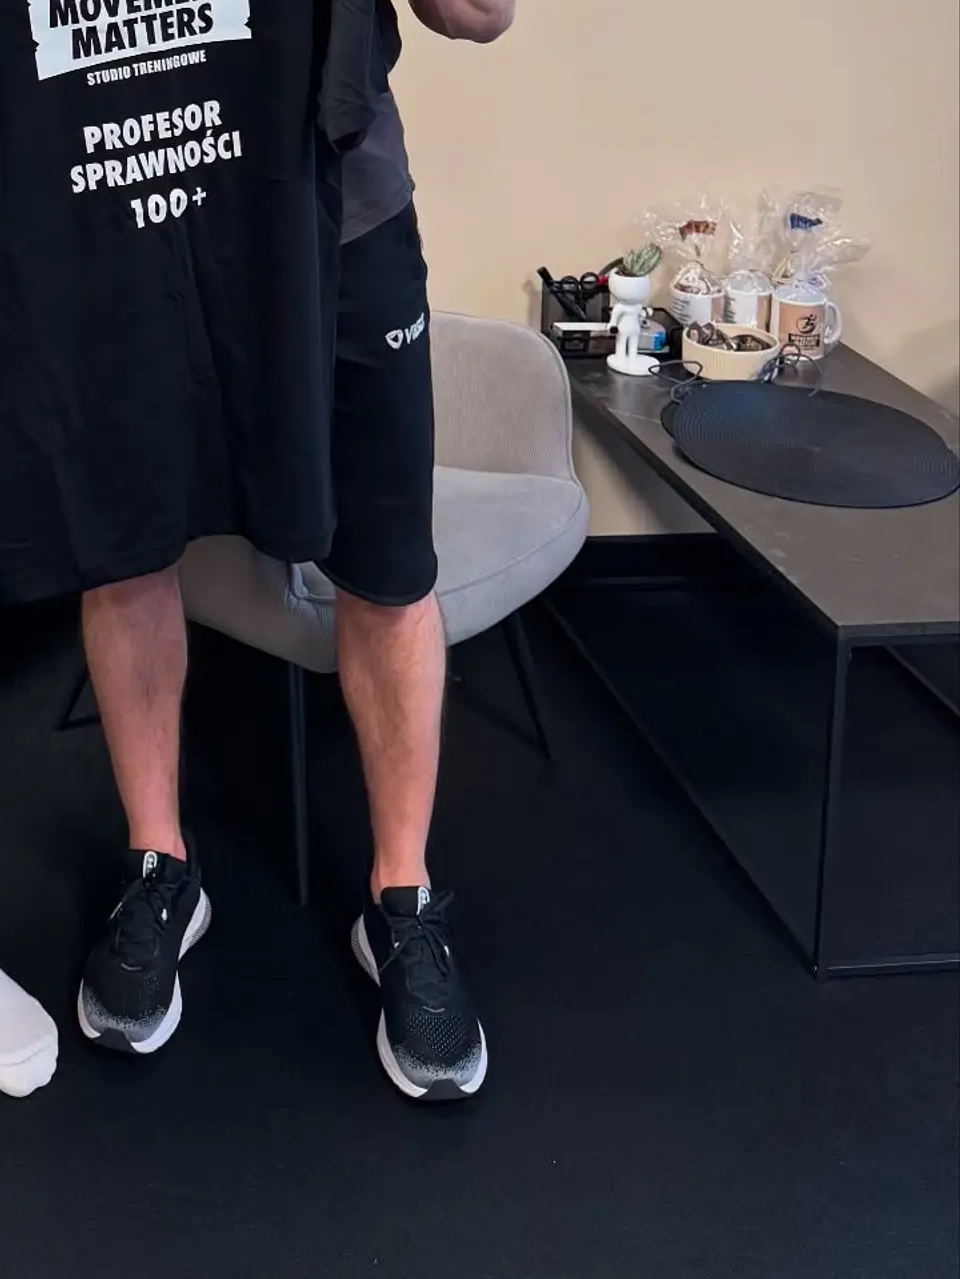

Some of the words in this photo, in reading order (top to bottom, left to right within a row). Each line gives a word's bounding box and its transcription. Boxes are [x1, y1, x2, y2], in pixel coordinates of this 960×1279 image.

[72, 3, 213, 60] MATTERS
[87, 66, 131, 86] STUDIO
[132, 50, 207, 76] TRENINGOWE
[83, 100, 222, 153] PROFESOR
[70, 130, 242, 193] SPRAWNOŚCI
[131, 187, 206, 228] 100+
